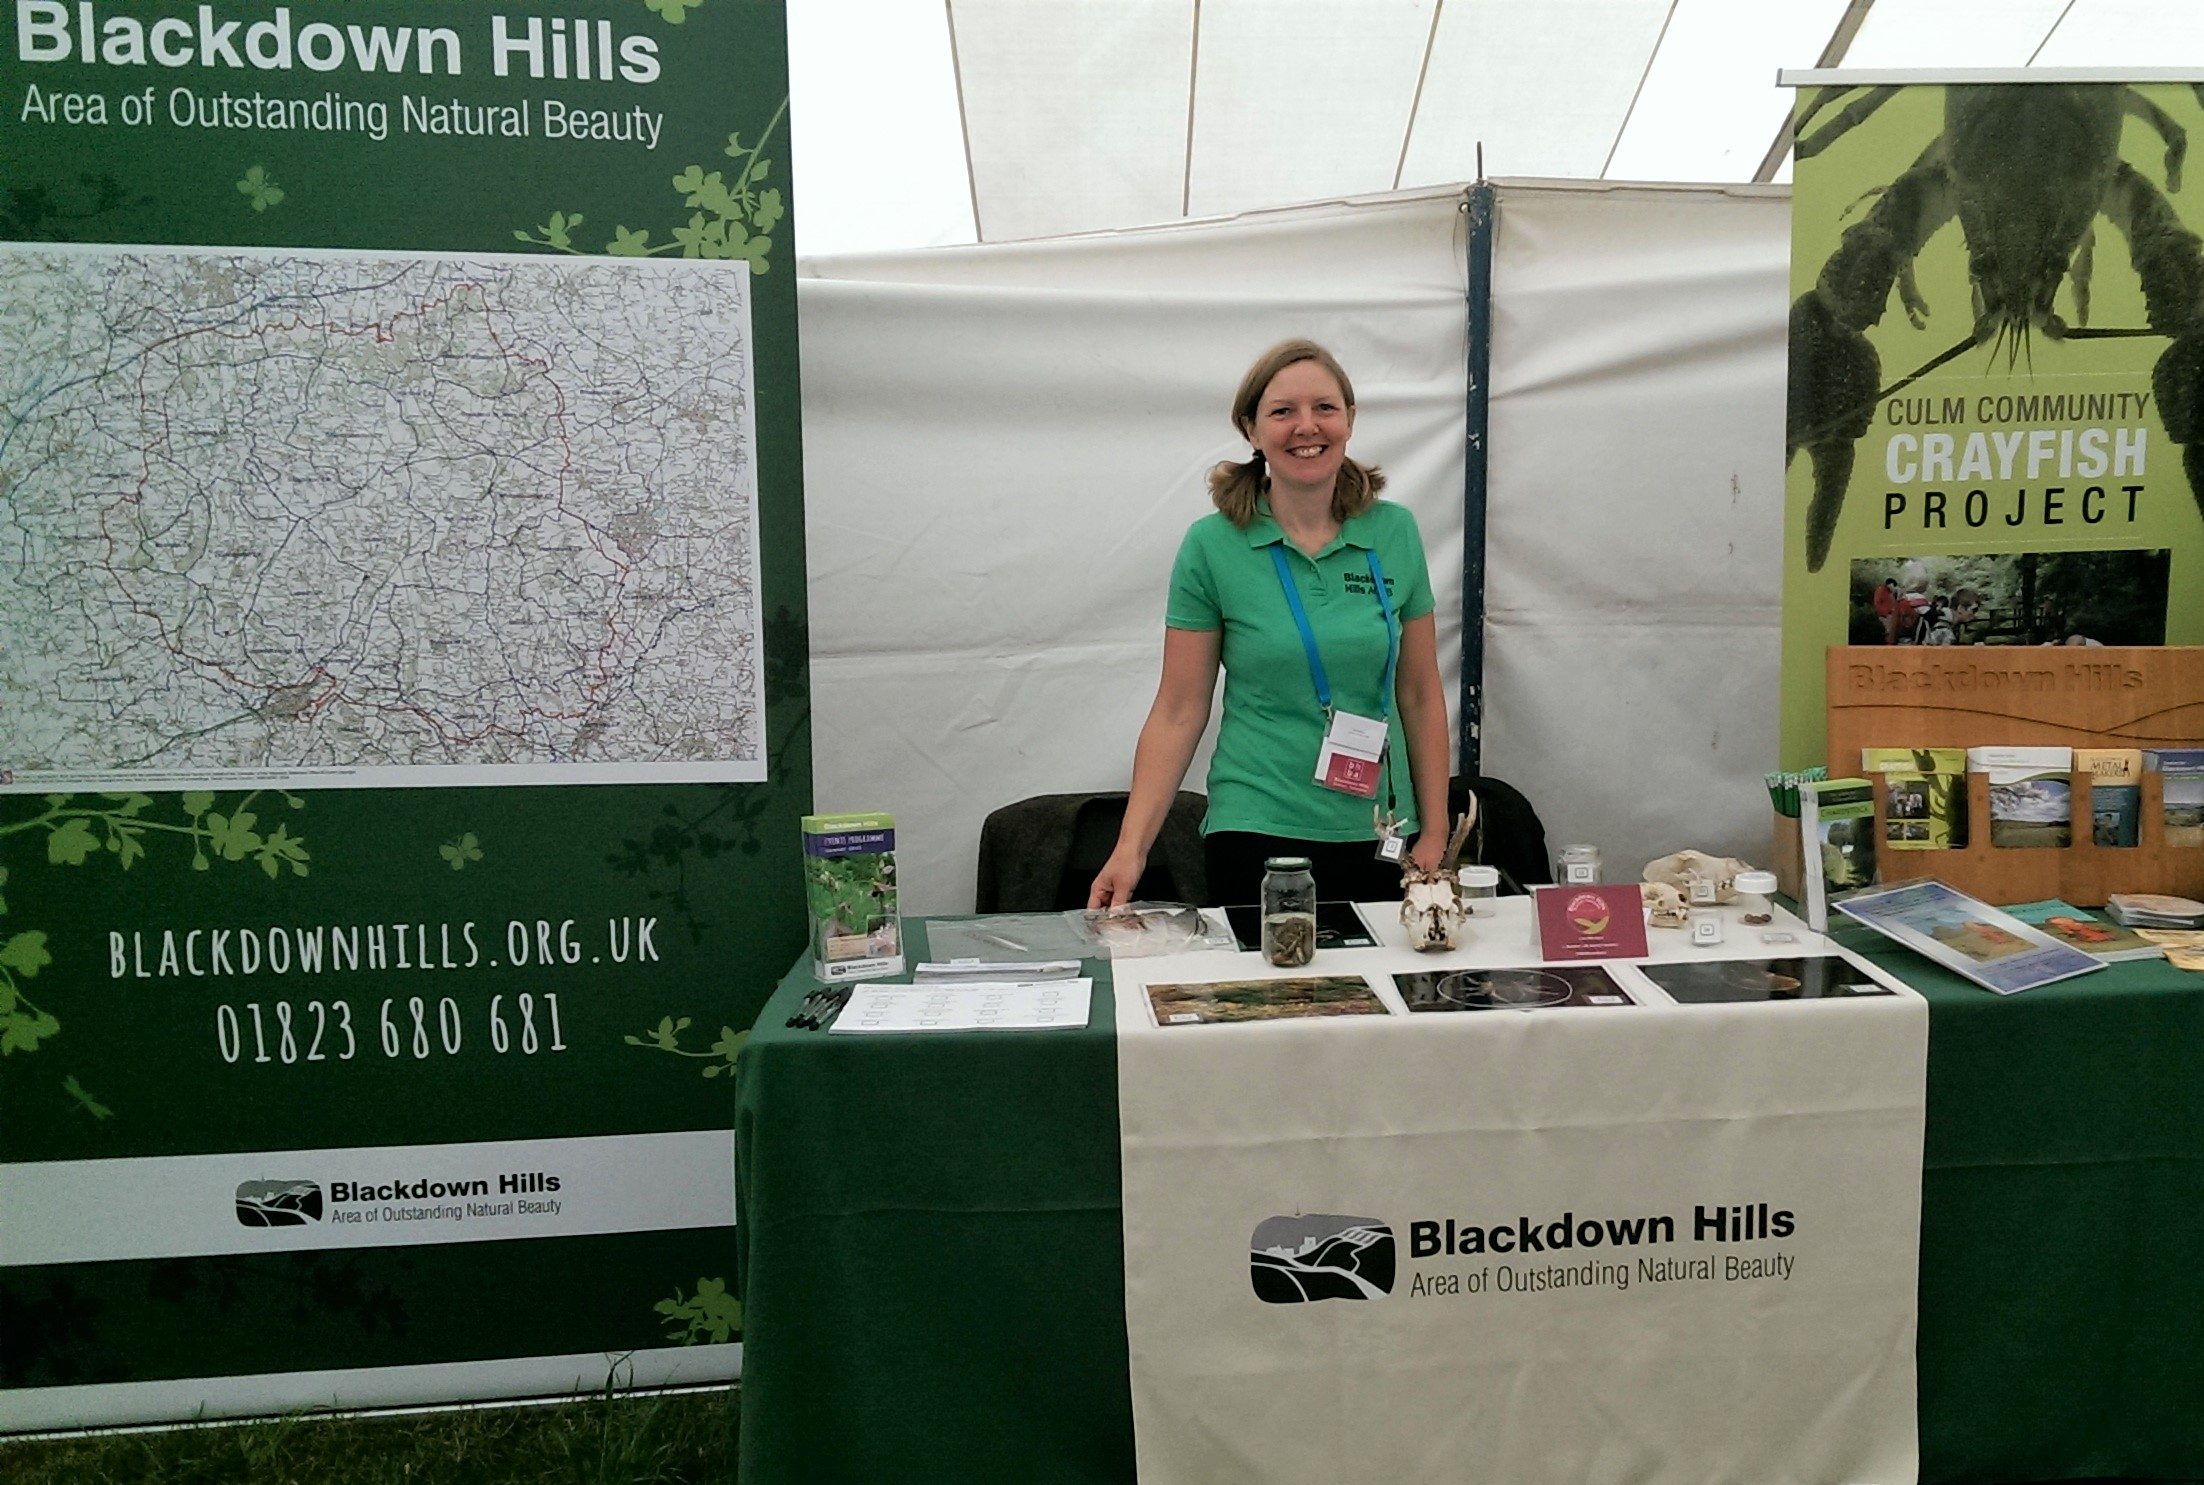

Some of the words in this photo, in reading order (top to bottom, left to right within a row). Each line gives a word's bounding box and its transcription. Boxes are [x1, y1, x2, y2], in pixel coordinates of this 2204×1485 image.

[16, 0, 462, 75] Blackdown
[491, 15, 661, 84] Hills
[21, 83, 109, 125] Area
[121, 86, 156, 126] of
[169, 87, 388, 141] Outstanding
[402, 94, 530, 137] Natural
[543, 100, 663, 150] Beauty
[1886, 396, 1965, 426] CULM
[1977, 392, 2150, 424] COMMUNITY
[1885, 427, 2147, 484] CRAYFISH
[1884, 485, 2145, 531] PROJECT
[1849, 664, 2056, 692] Blackdown
[2064, 662, 2144, 692] Hills
[109, 916, 659, 979] BLACKDOWNHILLS.ORG.UK
[217, 1000, 356, 1064] 01823
[380, 996, 462, 1059] 680
[490, 992, 567, 1055] 681
[330, 1178, 489, 1203] Blackdown
[499, 1172, 561, 1195] Hills
[331, 1209, 362, 1224] Area
[365, 1207, 379, 1223] of
[381, 1203, 462, 1223] Outstanding
[466, 1201, 514, 1217] Natural
[517, 1199, 562, 1217] Beauty
[1410, 1212, 1674, 1259] Blackdown
[1694, 1203, 1795, 1242] Hills
[1410, 1270, 1459, 1298] Area
[1467, 1266, 1489, 1294] of
[1496, 1259, 1629, 1294] Outstanding
[1637, 1254, 1716, 1284] Natural
[1725, 1252, 1795, 1282] Beauty
